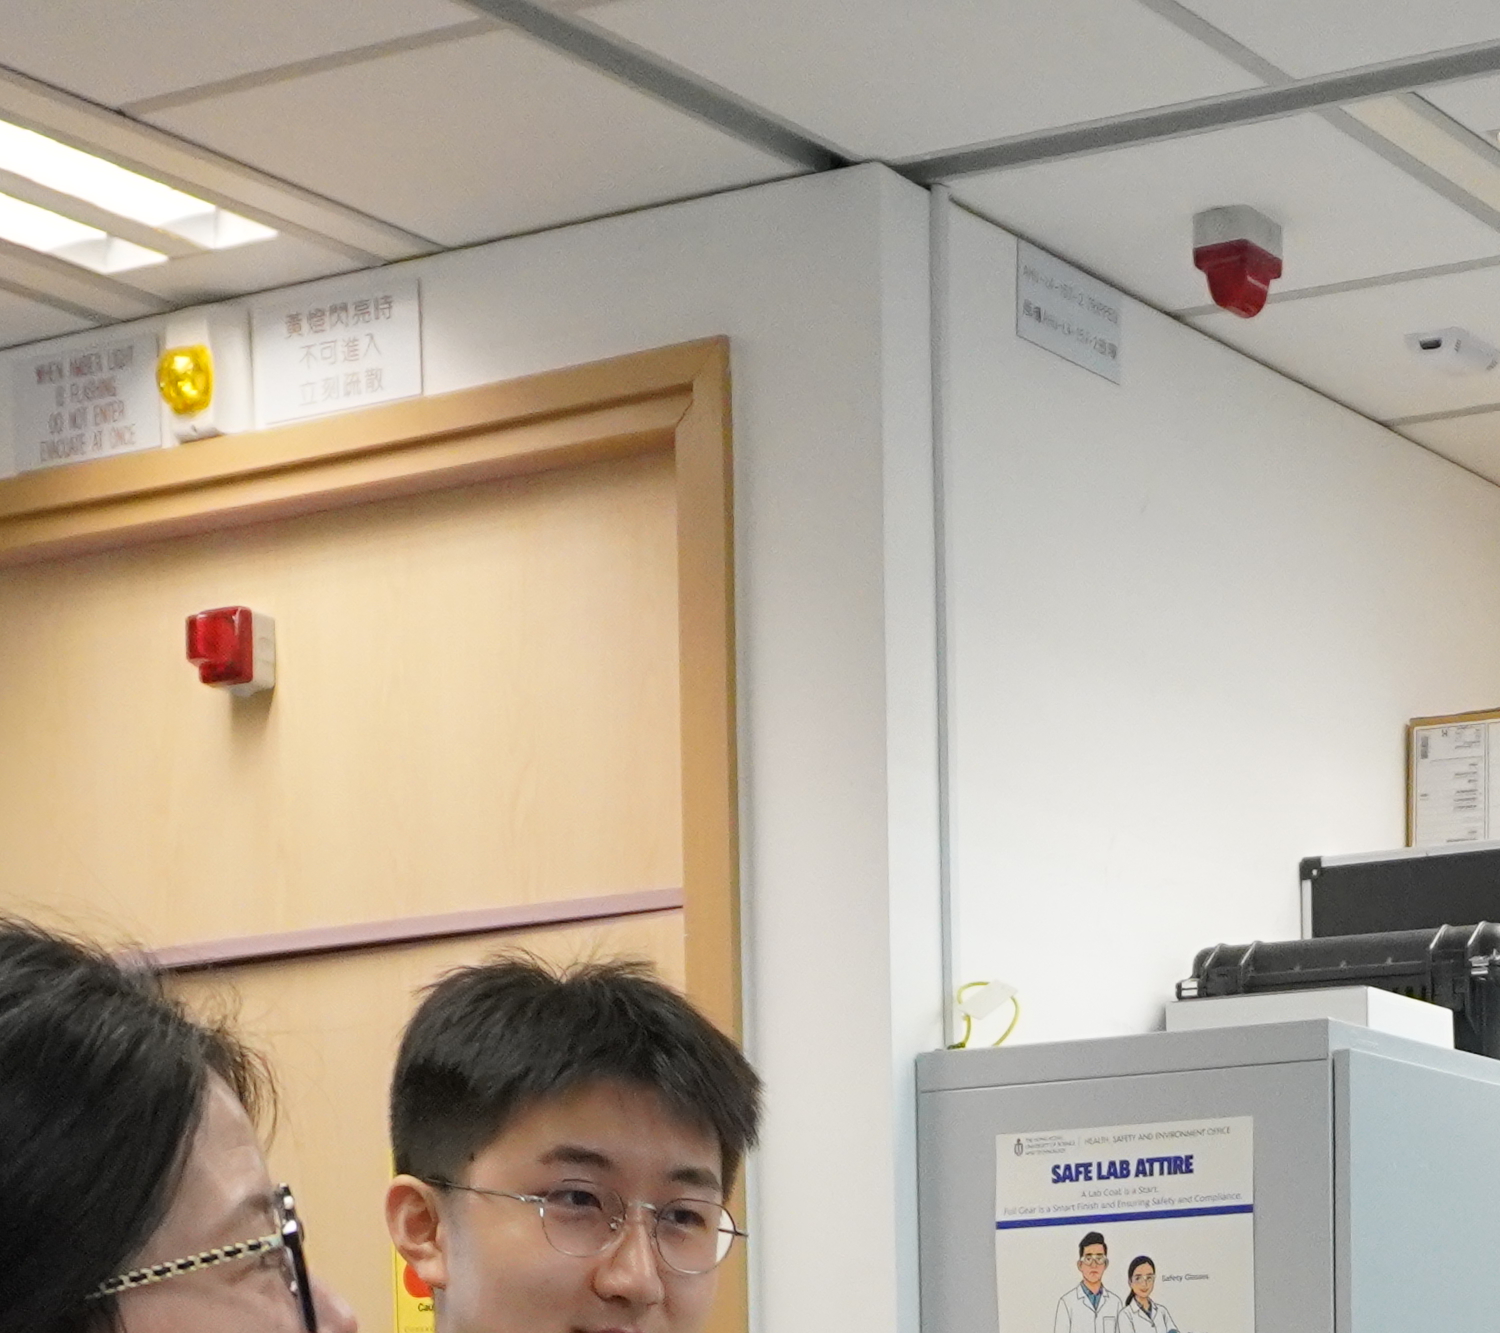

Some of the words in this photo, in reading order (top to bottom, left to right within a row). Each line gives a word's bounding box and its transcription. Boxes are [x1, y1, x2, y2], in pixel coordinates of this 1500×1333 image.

[299, 332, 382, 369] 不可進入
[299, 367, 384, 408] 立刻疏散
[93, 400, 125, 427] ENTER
[1112, 1134, 1136, 1144] SAFETY
[1138, 1132, 1154, 1142] AND
[1155, 1128, 1206, 1140] ENVIRONMENT
[1051, 1163, 1093, 1184] SAFE
[1096, 1159, 1131, 1181] LAB
[1134, 1154, 1194, 1178] ATTIRE
[1088, 1189, 1101, 1197] Lab
[1103, 1187, 1122, 1197] Coat
[1018, 1206, 1036, 1215] Gear
[1052, 1203, 1076, 1213] Smart
[1076, 1202, 1098, 1211] Finish
[1101, 1200, 1115, 1209] and
[1117, 1198, 1150, 1209] Ensuring
[1152, 1196, 1175, 1206] Safety
[1177, 1195, 1192, 1203] and
[1162, 1274, 1183, 1282] Safety
[1184, 1273, 1209, 1281] Glasses
[417, 1302, 436, 1312] Cau
